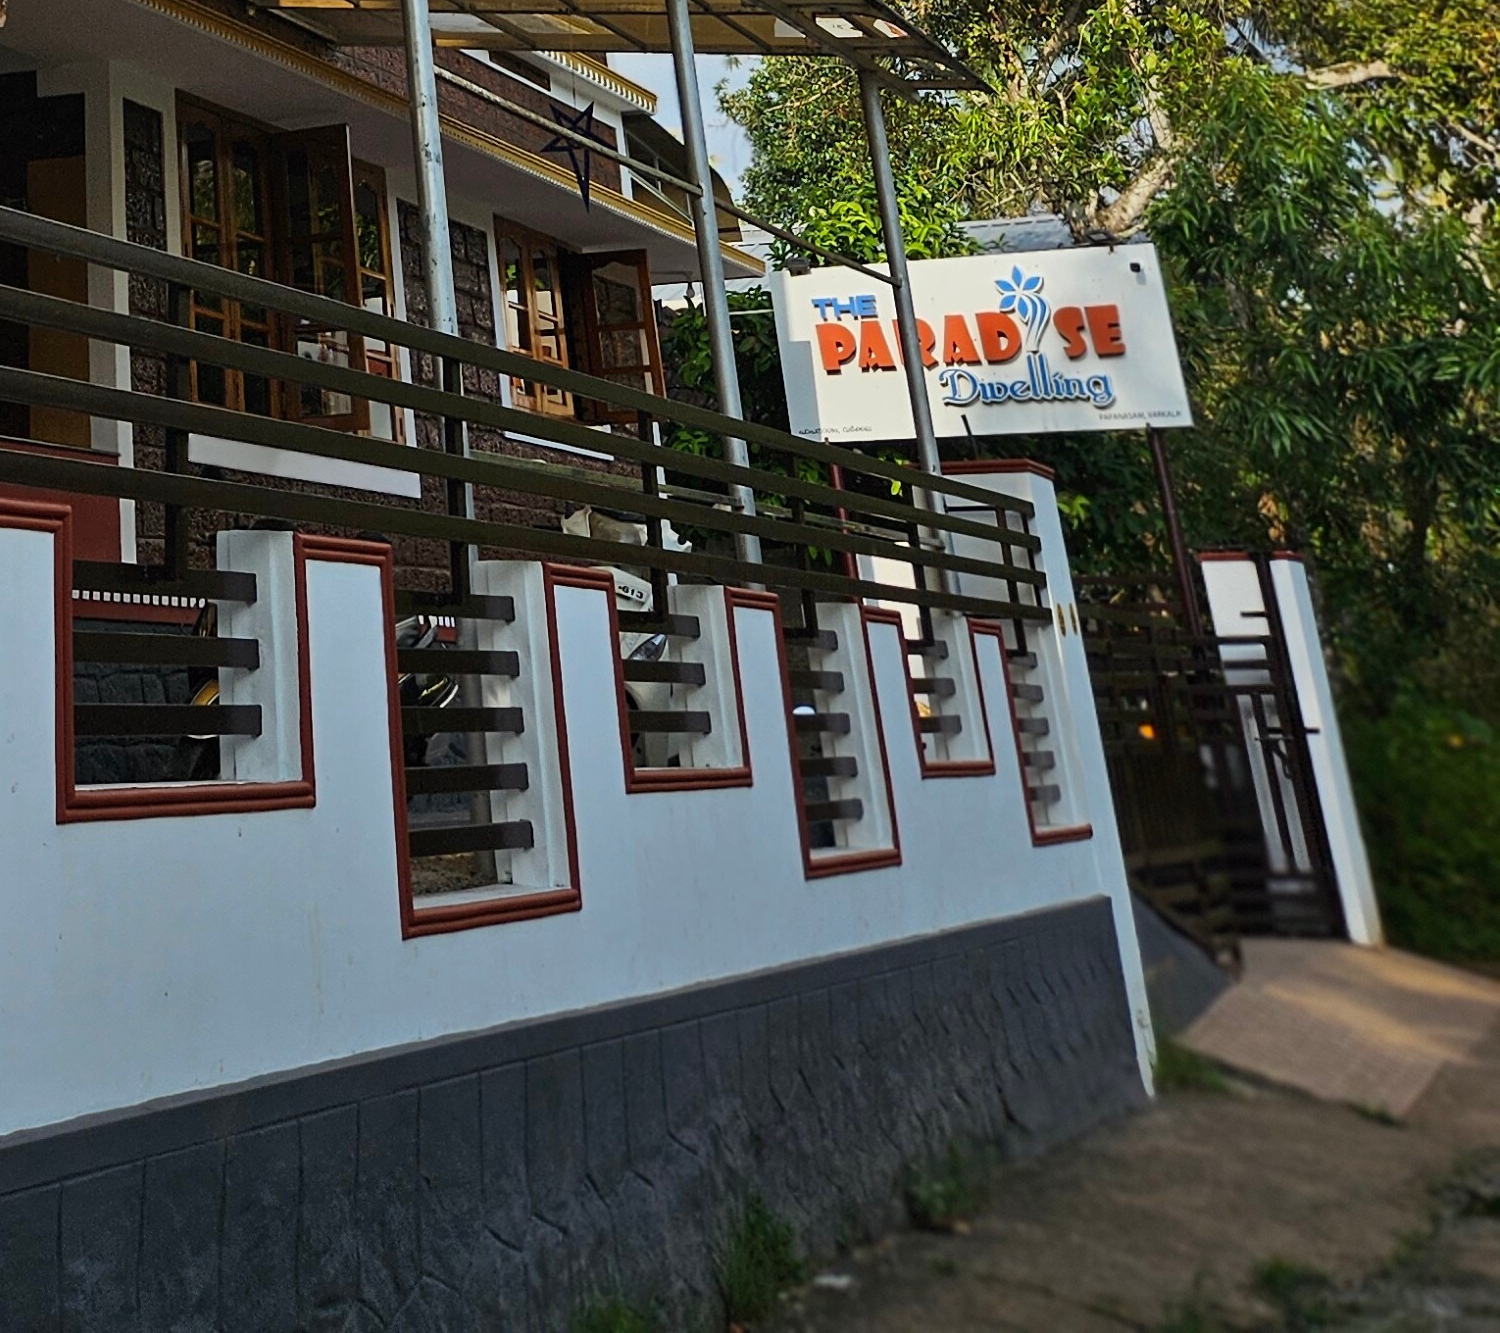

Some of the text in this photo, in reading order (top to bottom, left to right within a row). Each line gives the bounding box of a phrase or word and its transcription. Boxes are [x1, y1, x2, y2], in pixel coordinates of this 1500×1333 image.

[811, 294, 879, 320] THE
[815, 300, 1127, 373] PARADISE
[939, 352, 1116, 408] Dwelling
